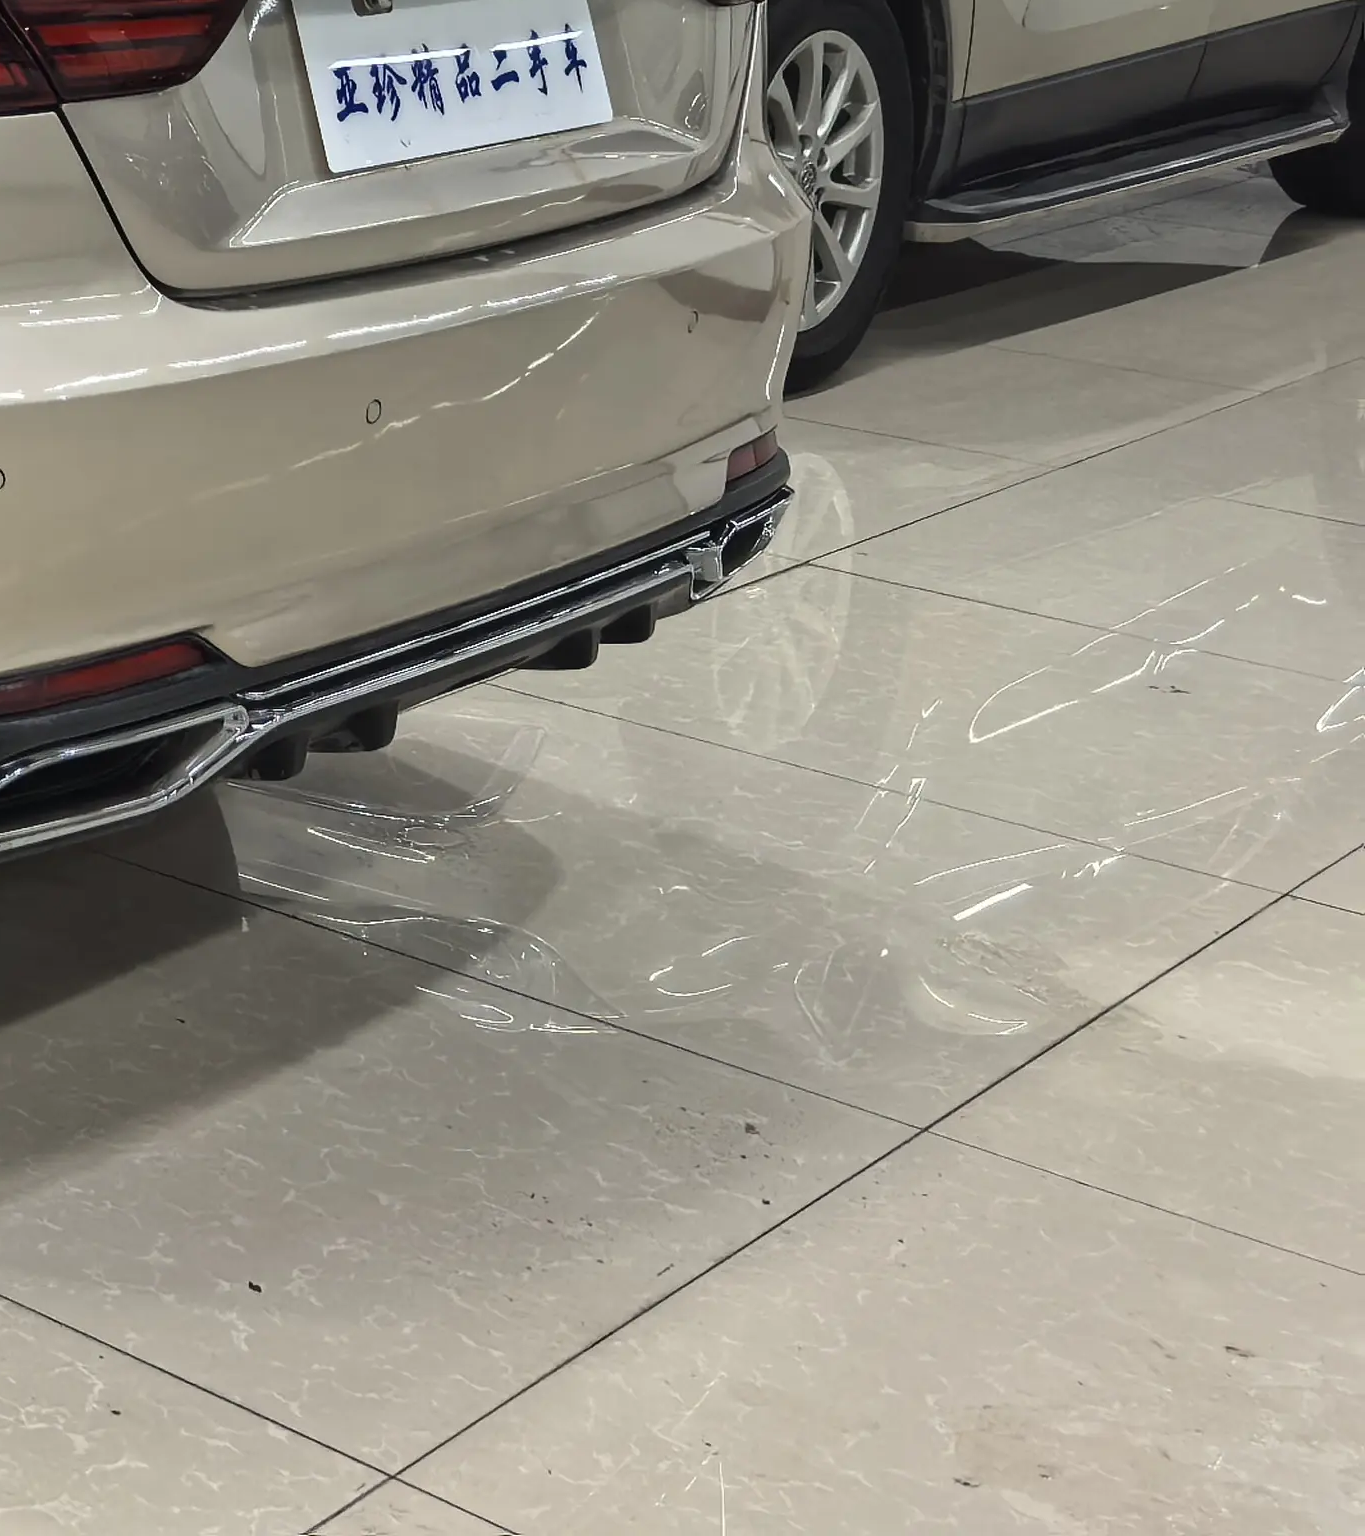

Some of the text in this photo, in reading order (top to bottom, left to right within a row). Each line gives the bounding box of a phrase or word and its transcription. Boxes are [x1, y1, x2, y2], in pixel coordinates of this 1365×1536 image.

[331, 23, 588, 122] 亚珍精品二手车
